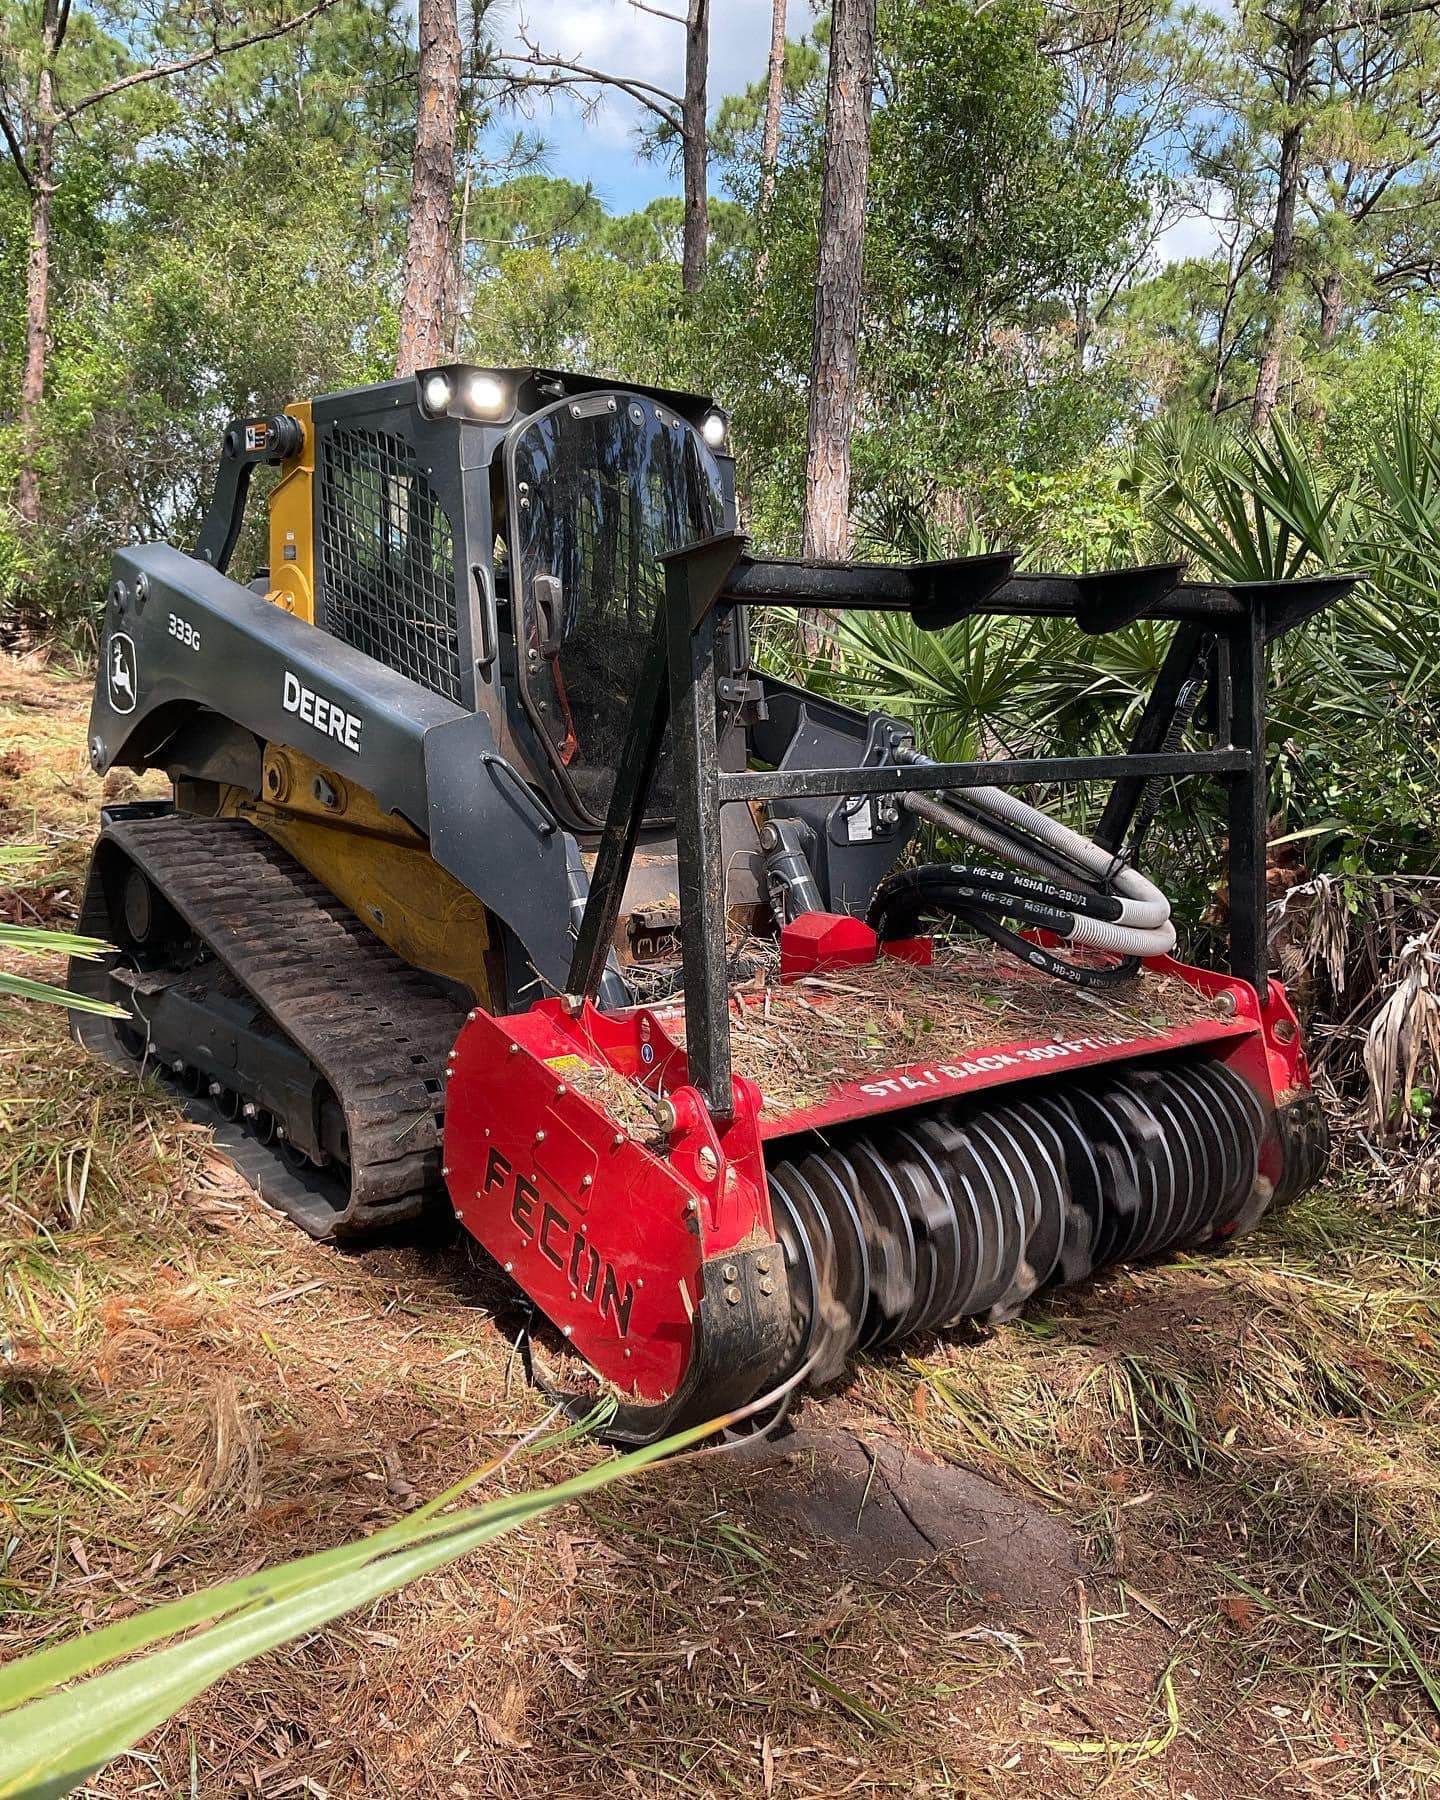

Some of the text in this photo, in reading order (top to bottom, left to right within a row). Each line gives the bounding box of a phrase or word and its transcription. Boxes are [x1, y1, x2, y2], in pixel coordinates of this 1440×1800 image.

[167, 613, 201, 652] 333G
[282, 670, 362, 754] DEERE
[972, 866, 1005, 881] HG-28
[1013, 875, 1044, 892] MSHA
[981, 891, 1014, 907] HG-28
[1024, 902, 1054, 917] MSHA
[937, 1053, 1021, 1079] BACK
[483, 1145, 634, 1339] FECON
